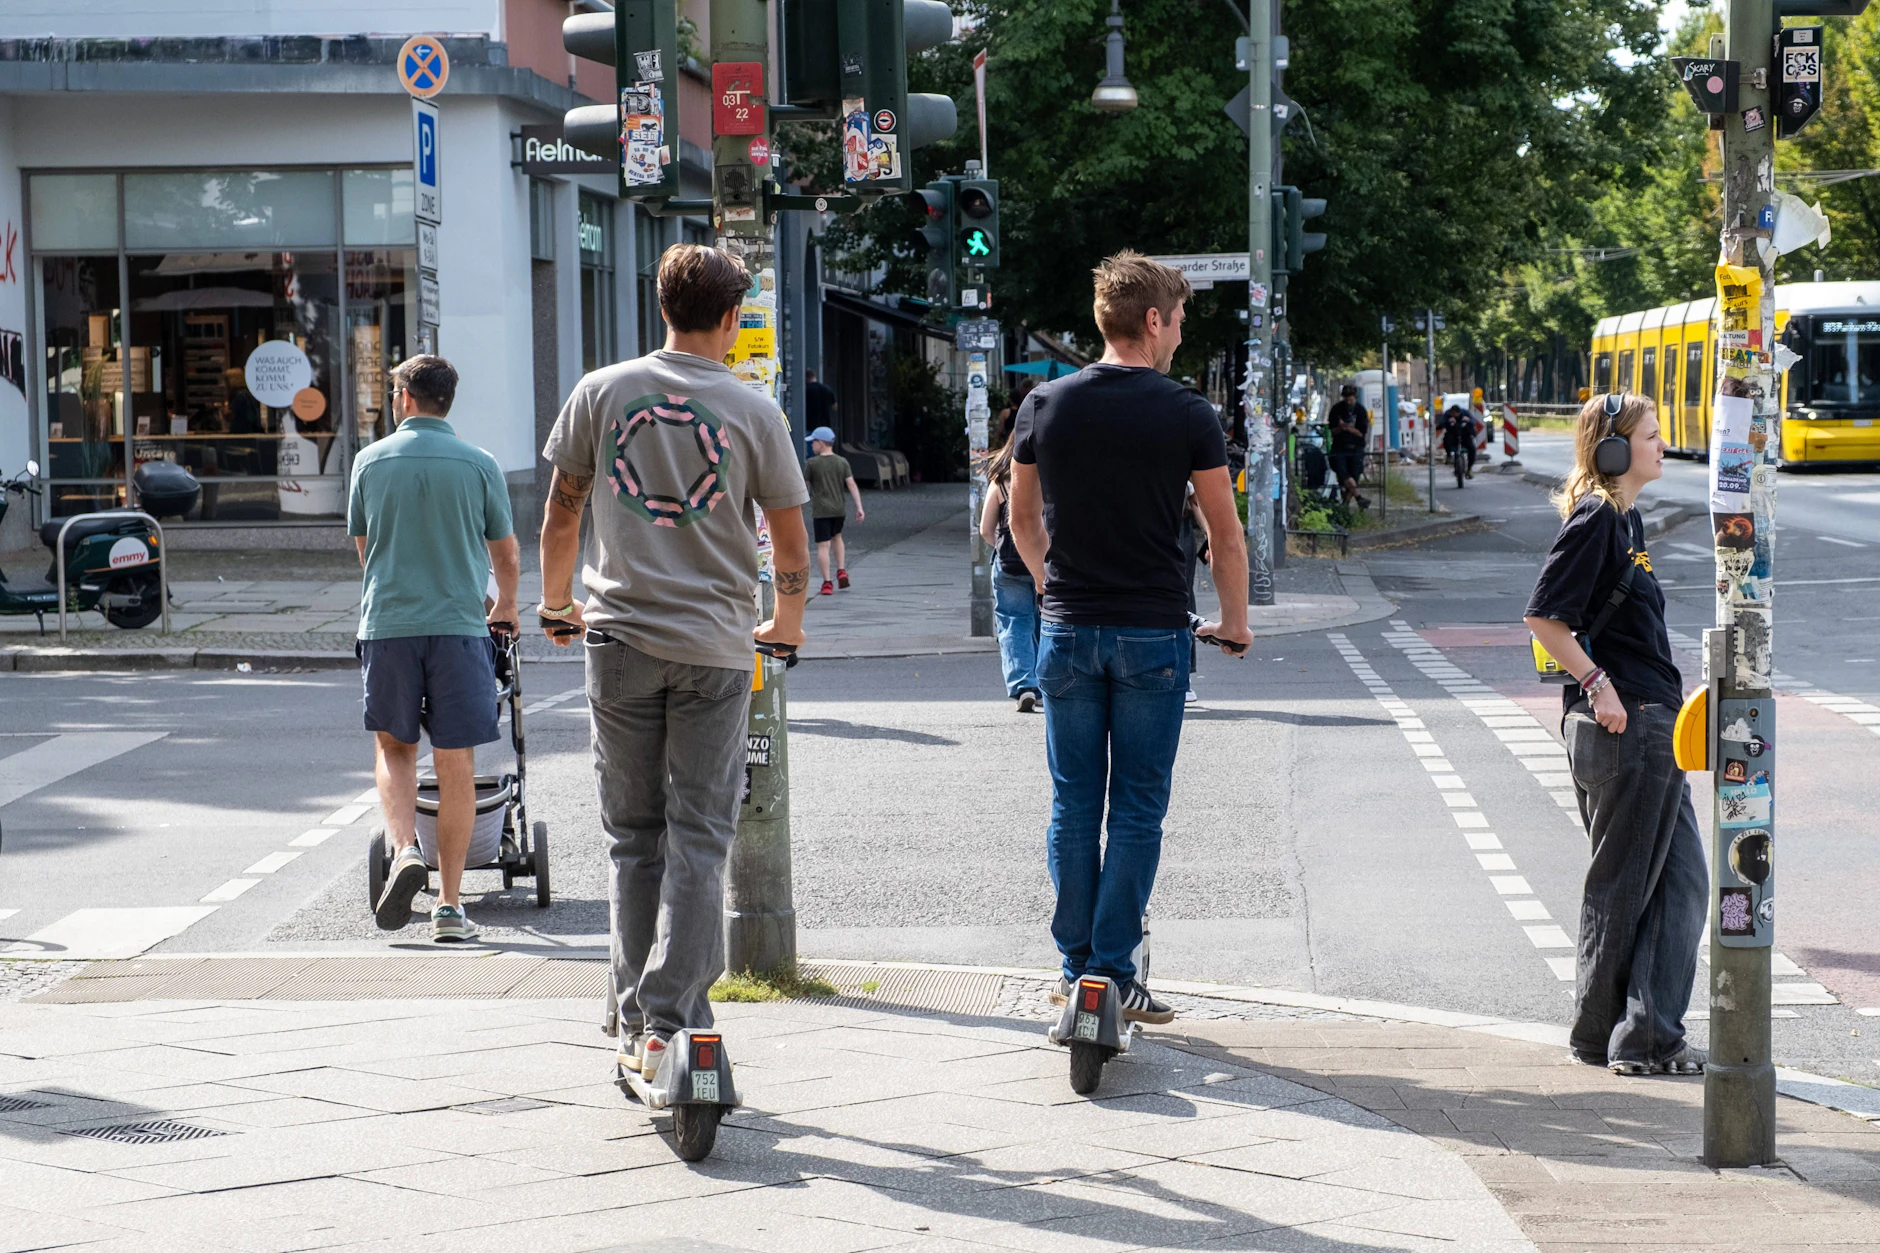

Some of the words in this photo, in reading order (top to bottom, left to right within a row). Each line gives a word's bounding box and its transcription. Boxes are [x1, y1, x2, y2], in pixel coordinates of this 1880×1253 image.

[1688, 62, 1716, 74] SKARY
[421, 123, 432, 174] P
[254, 356, 275, 365] WAS
[276, 356, 302, 365] AUCH
[255, 374, 286, 382] KOMM
[134, 449, 176, 459] Unsere
[112, 551, 146, 565] emmy
[695, 1073, 716, 1086] 752
